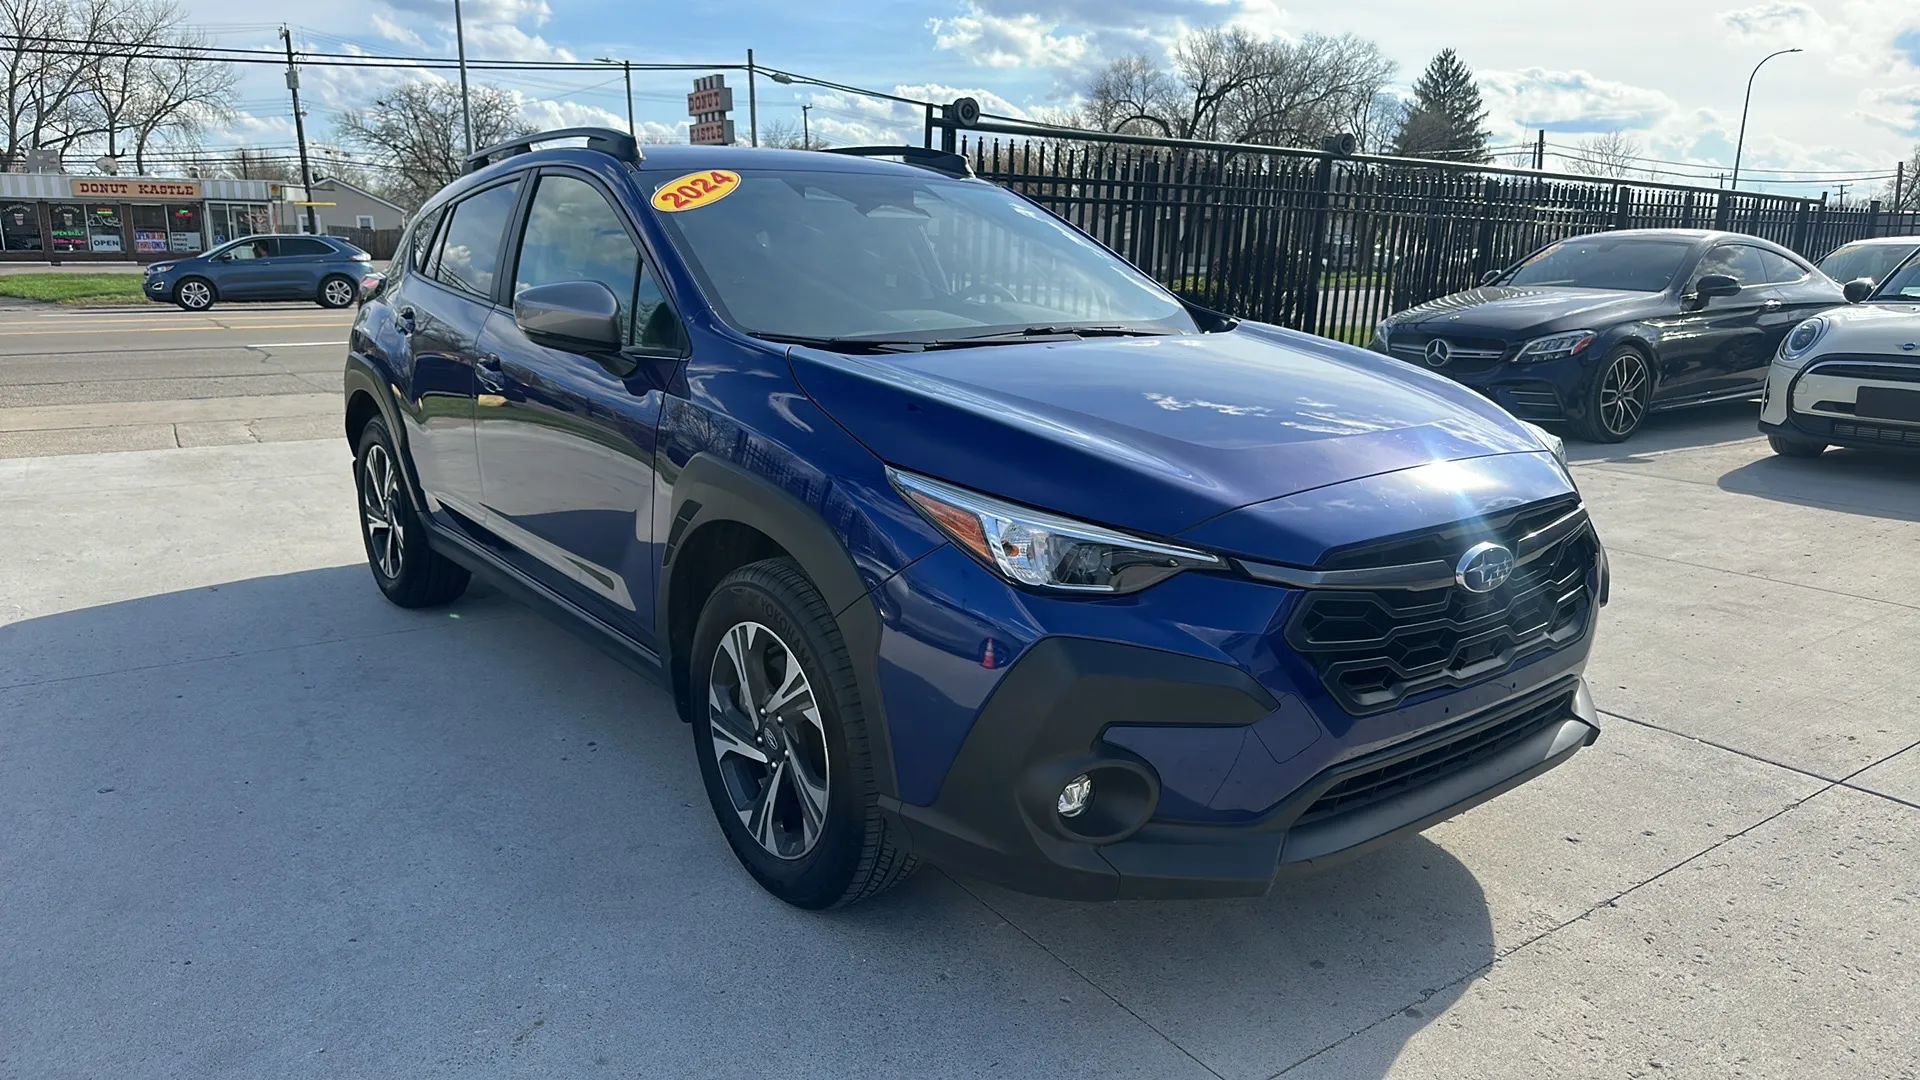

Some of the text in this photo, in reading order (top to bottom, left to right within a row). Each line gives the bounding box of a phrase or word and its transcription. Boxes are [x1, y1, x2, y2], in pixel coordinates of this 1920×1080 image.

[688, 91, 720, 111] DONUT
[690, 125, 722, 142] KASTLE
[80, 183, 194, 195] DONUT KASTLE
[661, 171, 733, 208] 2024
